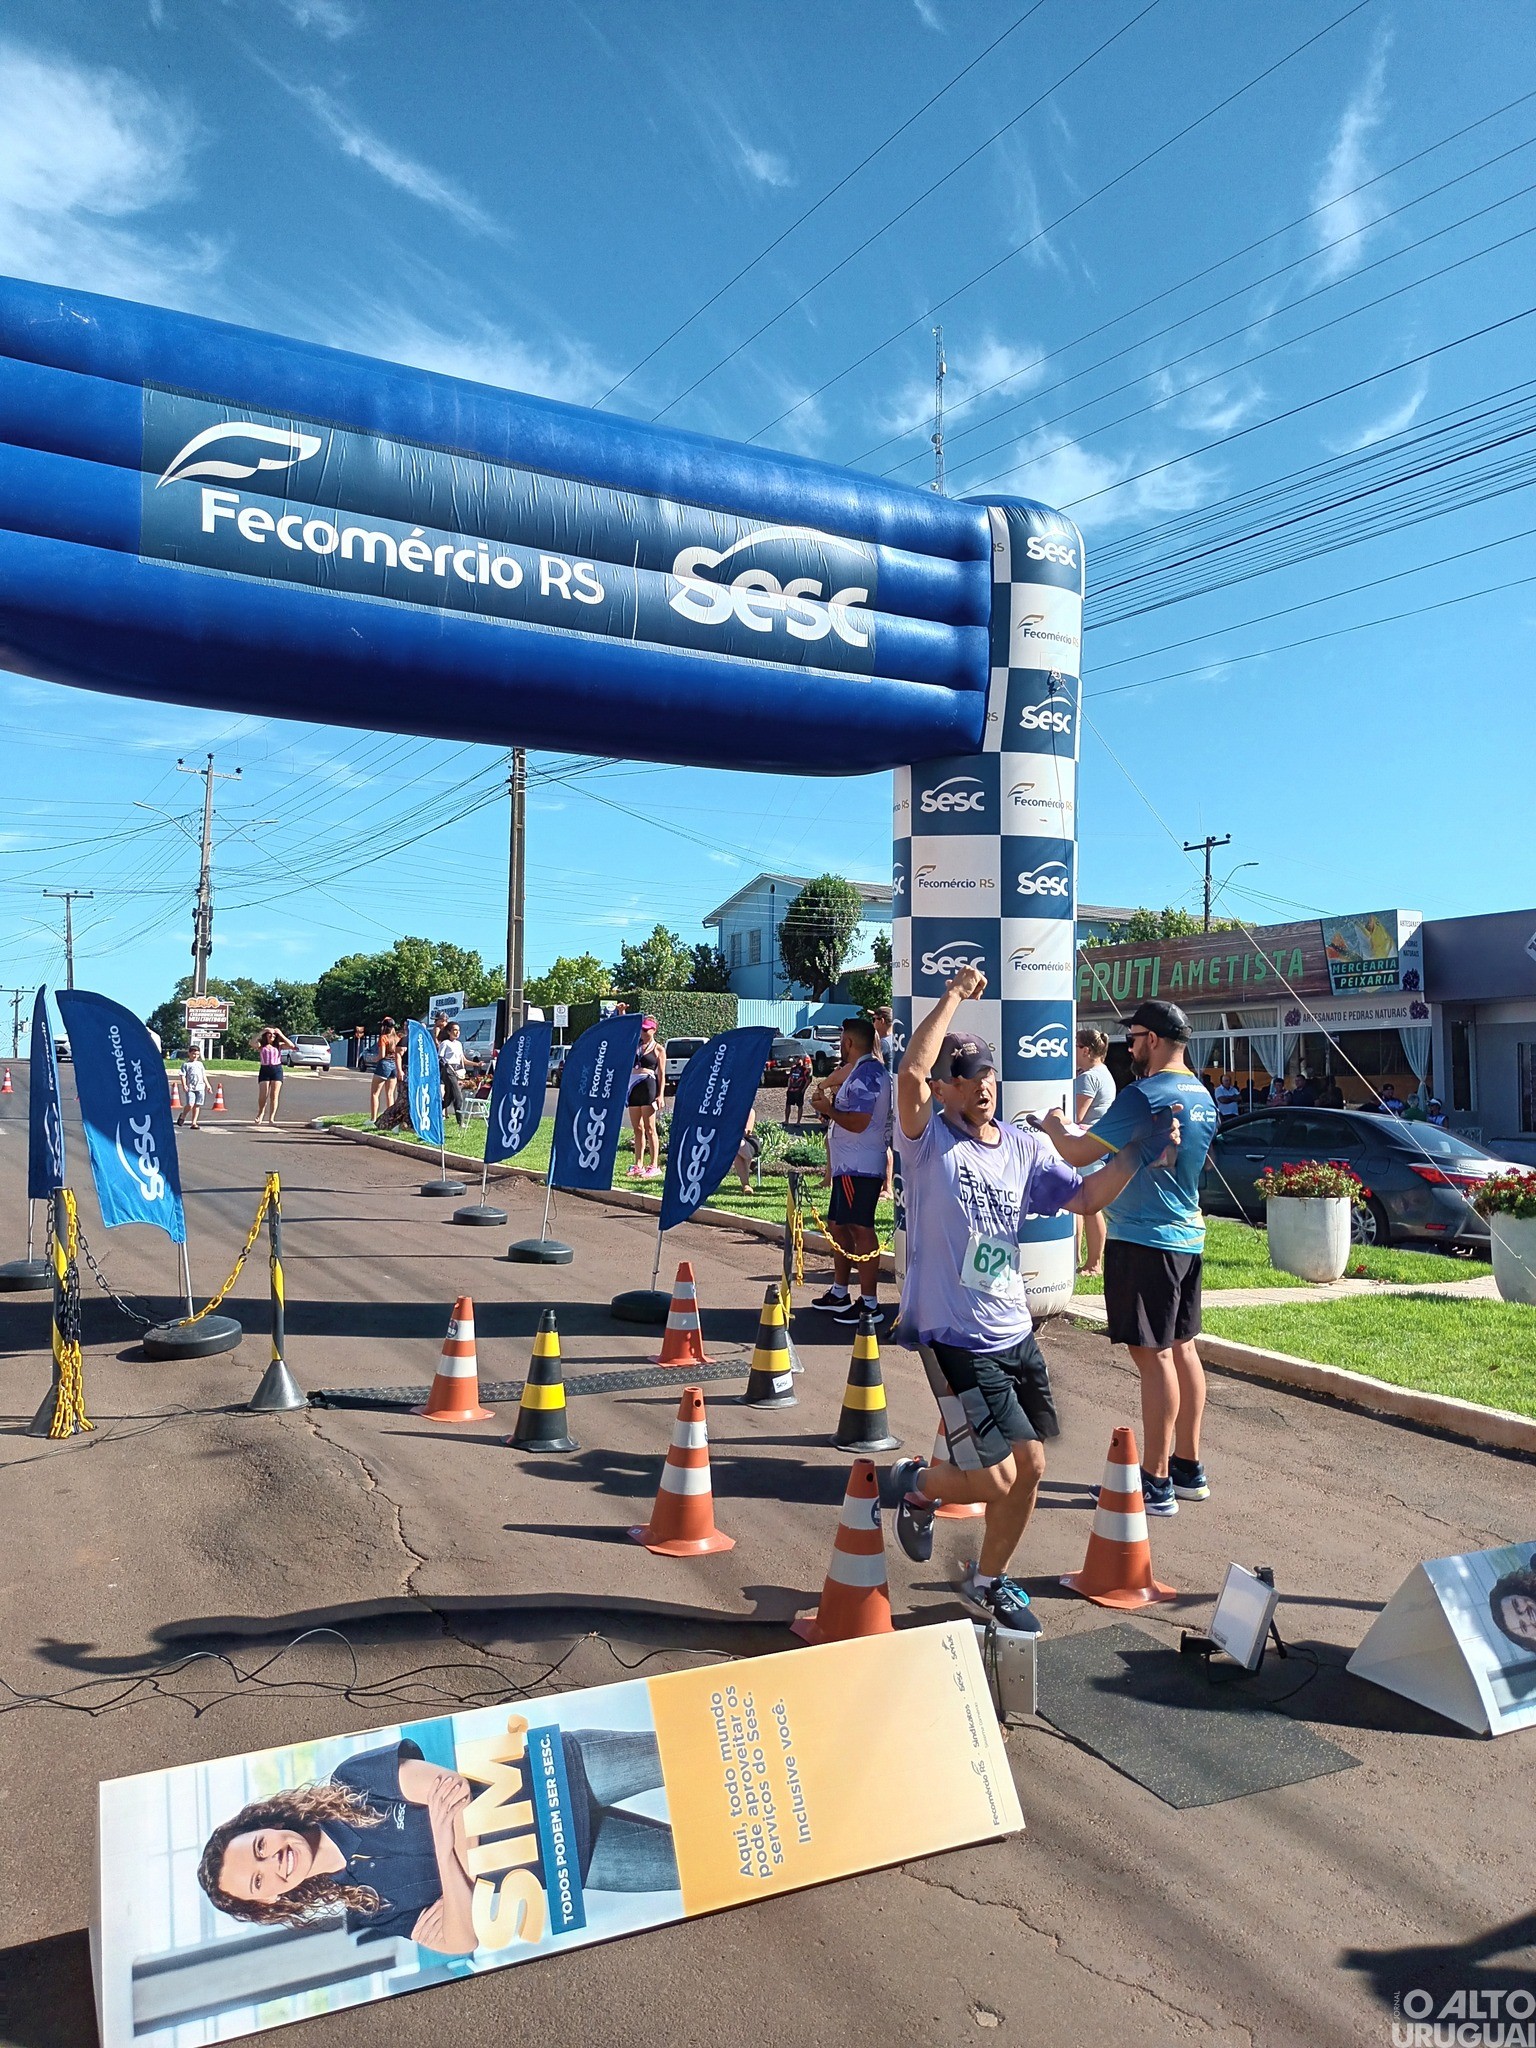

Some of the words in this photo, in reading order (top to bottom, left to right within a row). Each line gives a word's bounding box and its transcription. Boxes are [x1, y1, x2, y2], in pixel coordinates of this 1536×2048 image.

[200, 488, 523, 590] Fecomércio
[539, 553, 605, 606] RS
[1026, 531, 1077, 570] Sesc
[669, 532, 869, 648] Sesc
[1023, 628, 1072, 645] Fecomércio
[1072, 636, 1079, 648] RS
[1019, 701, 1072, 734] Sesc
[920, 783, 985, 813] Sesc
[1014, 797, 1065, 811] Fecomércio
[1065, 801, 1073, 811] RS
[918, 878, 976, 889] Fecomércio
[979, 878, 995, 889] RS
[1017, 866, 1069, 897] Sesc
[1014, 961, 1064, 972] Fecomércio
[1076, 956, 1161, 1002] FRUTI
[1170, 948, 1304, 988] AMETISTA
[1332, 960, 1397, 974] MERCEARIA
[1340, 974, 1394, 988] PEIXARIA
[1303, 1011, 1342, 1023] ARTESANATO
[1343, 1012, 1348, 1021] E
[1349, 1010, 1374, 1021] PEDRAS
[1375, 1007, 1408, 1019] NATURAIS
[109, 1025, 132, 1104] Fecomércio
[512, 1036, 525, 1086] Fecomércio
[589, 1040, 608, 1097] Fecomércio
[1018, 1029, 1068, 1058] Sesc
[131, 1059, 147, 1101] Senac
[522, 1060, 531, 1086] Senac
[602, 1068, 615, 1098] Senac
[699, 1043, 727, 1115] Fecomércio
[713, 1078, 730, 1116] Senac
[500, 1093, 526, 1150] Sesc
[576, 1106, 607, 1171] Sesc
[126, 1114, 165, 1201] Sesc
[678, 1126, 716, 1206] Sesc
[1024, 1281, 1067, 1295] ecomércio
[725, 1685, 739, 1709] os
[742, 1691, 760, 1742] Sesc.
[711, 1692, 734, 1762] mundo
[772, 1698, 793, 1751] você.
[539, 1733, 557, 1778] SESC.
[730, 1714, 760, 1817] aproveitar
[752, 1748, 767, 1775] do
[978, 1760, 986, 1773] RS
[545, 1779, 561, 1810] SER
[724, 1767, 743, 1818] todo
[785, 1755, 812, 1844] Inclusive
[983, 1774, 1000, 1826] Fecomércio
[550, 1810, 568, 1868] PODEM
[759, 1780, 784, 1865] serviços
[732, 1822, 755, 1877] Aqui,
[750, 1823, 774, 1879] pode
[557, 1869, 575, 1925] TODOS
